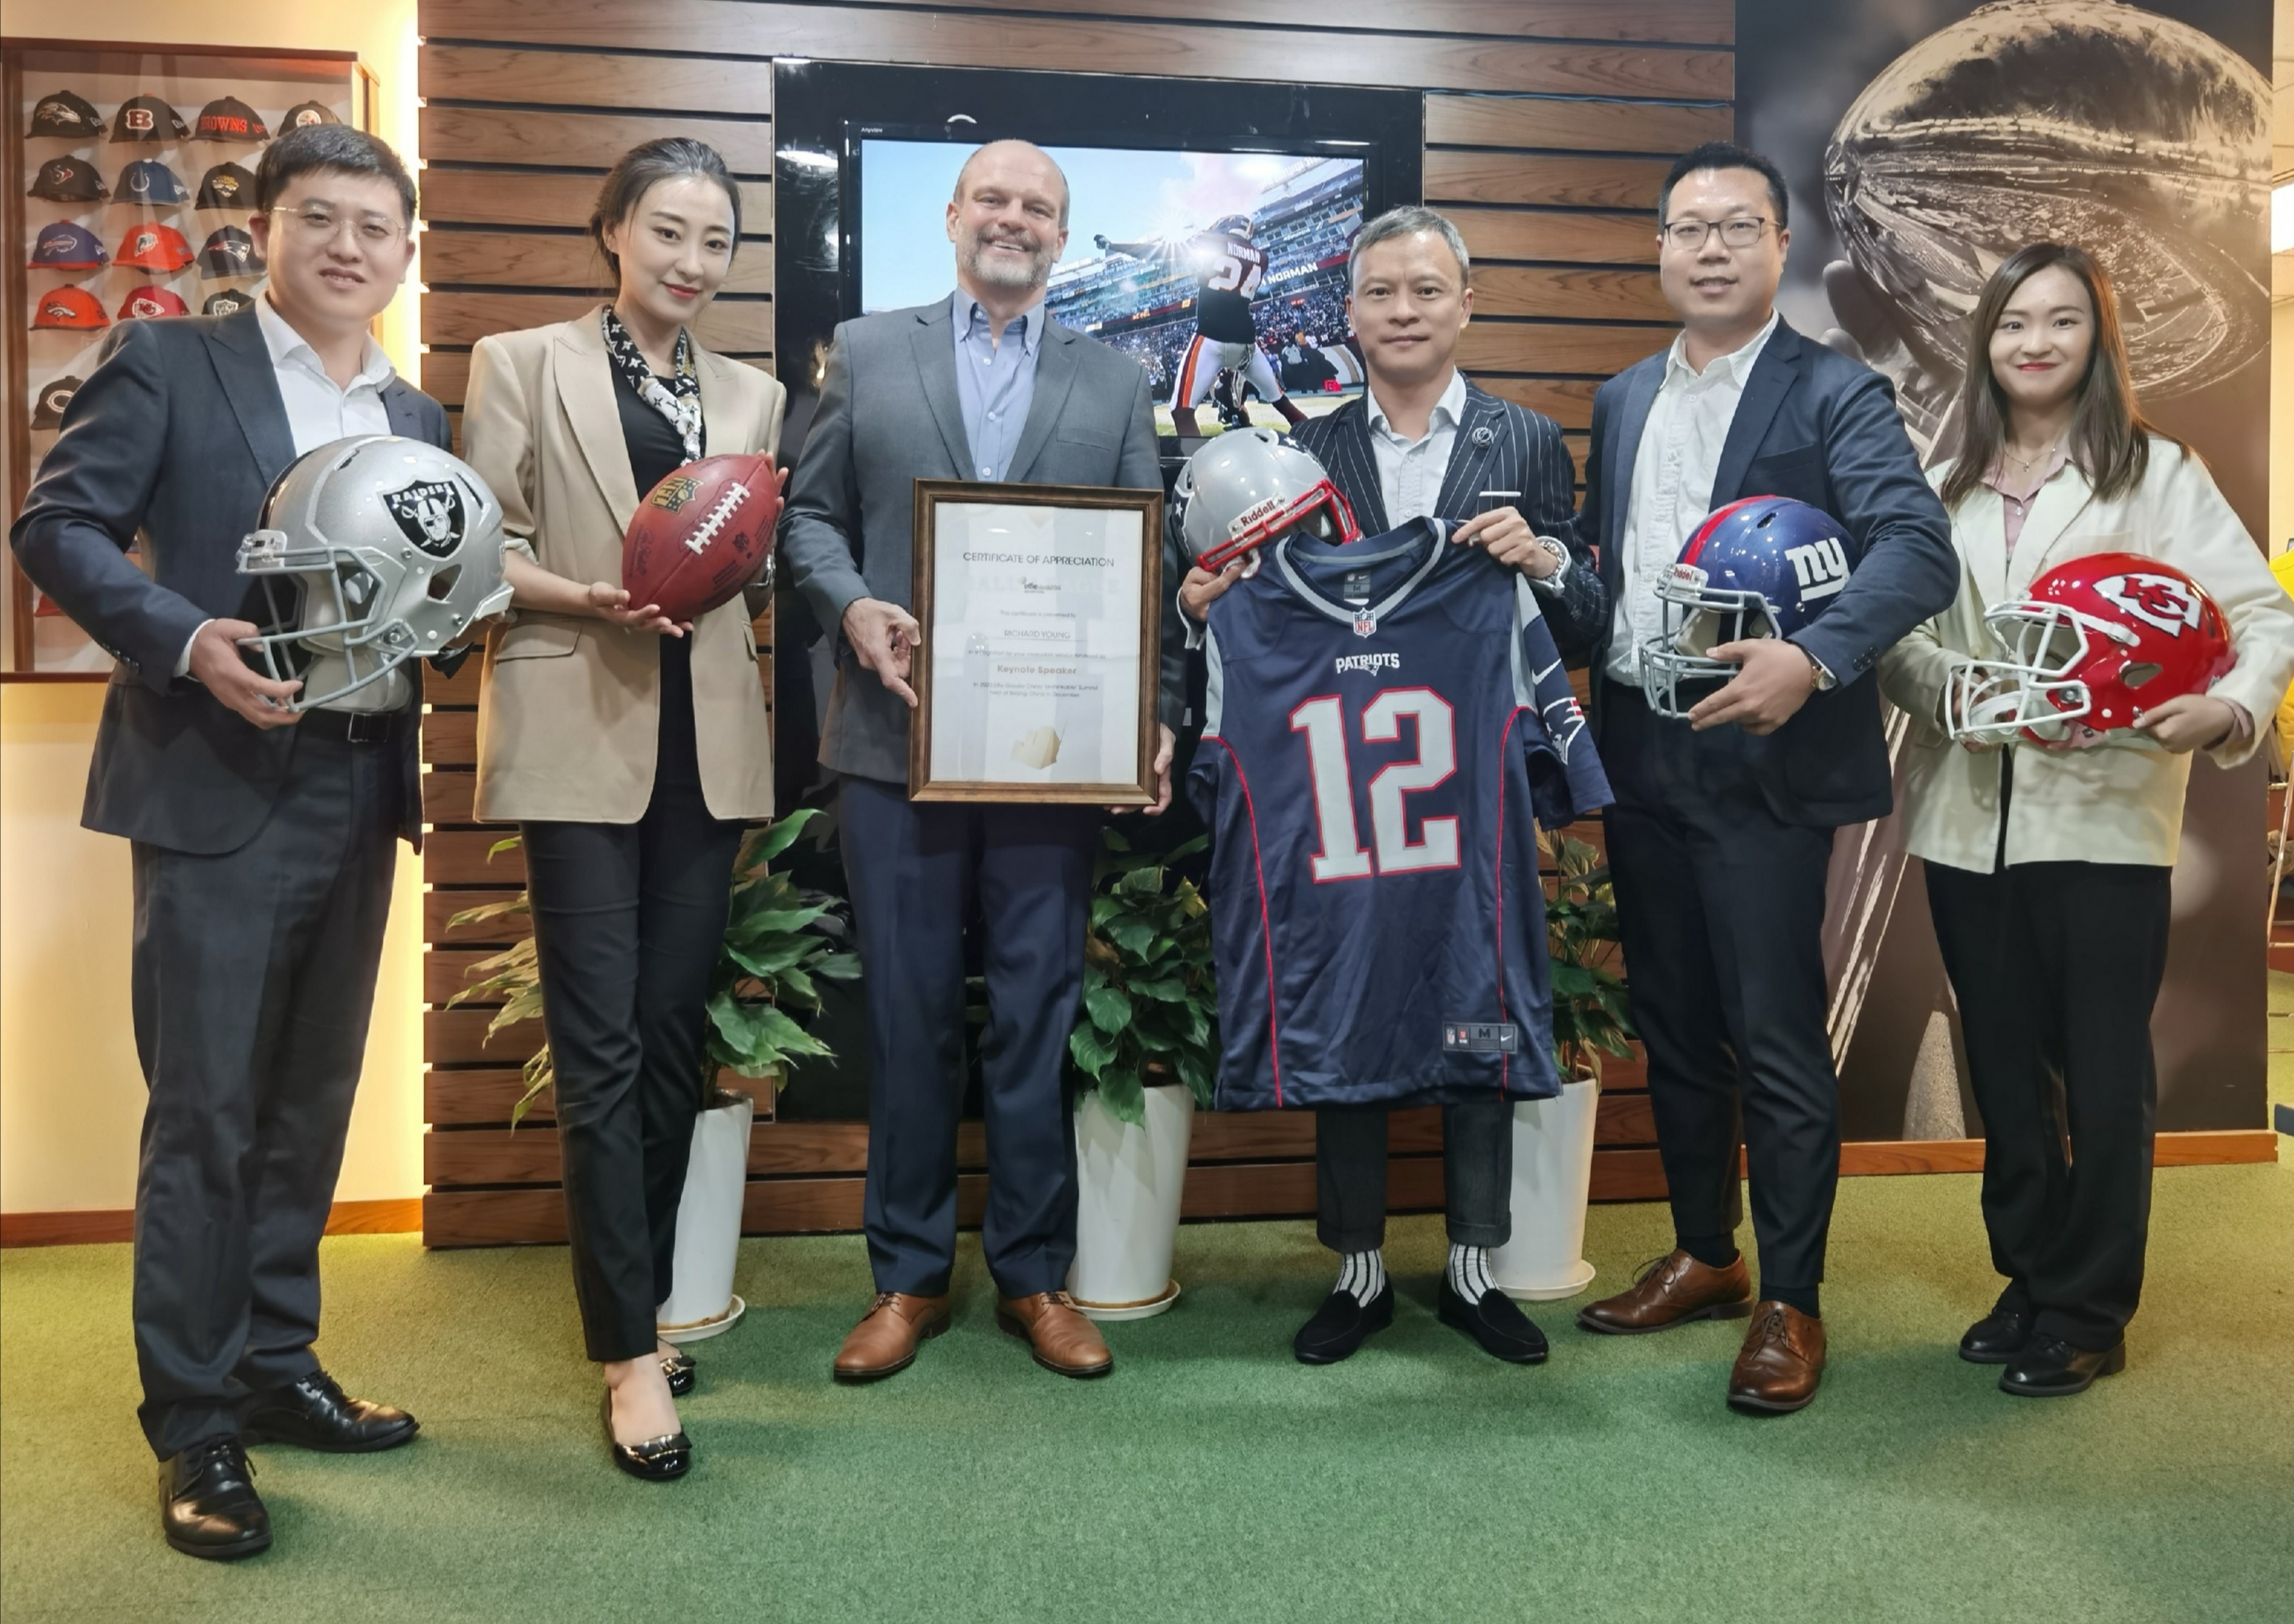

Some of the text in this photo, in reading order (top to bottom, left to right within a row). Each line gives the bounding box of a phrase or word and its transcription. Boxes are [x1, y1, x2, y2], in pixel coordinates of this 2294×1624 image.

[200, 116, 247, 133] BROWNS
[1227, 241, 1260, 264] NORMAN
[1207, 258, 1262, 300] 24
[1268, 262, 1319, 284] NORMAN
[392, 483, 452, 504] RAIDERS
[653, 476, 688, 507] NFL
[1240, 501, 1276, 526] Riddell
[963, 552, 1115, 567] CERTIFICATE OF APPRECIATION
[2120, 575, 2189, 620] KC
[1357, 621, 1374, 632] NFL
[998, 665, 1077, 675] Keynote Speaker
[1335, 653, 1400, 674] PATRIOTS
[1288, 686, 1461, 883] 12
[1479, 1028, 1491, 1038] M
